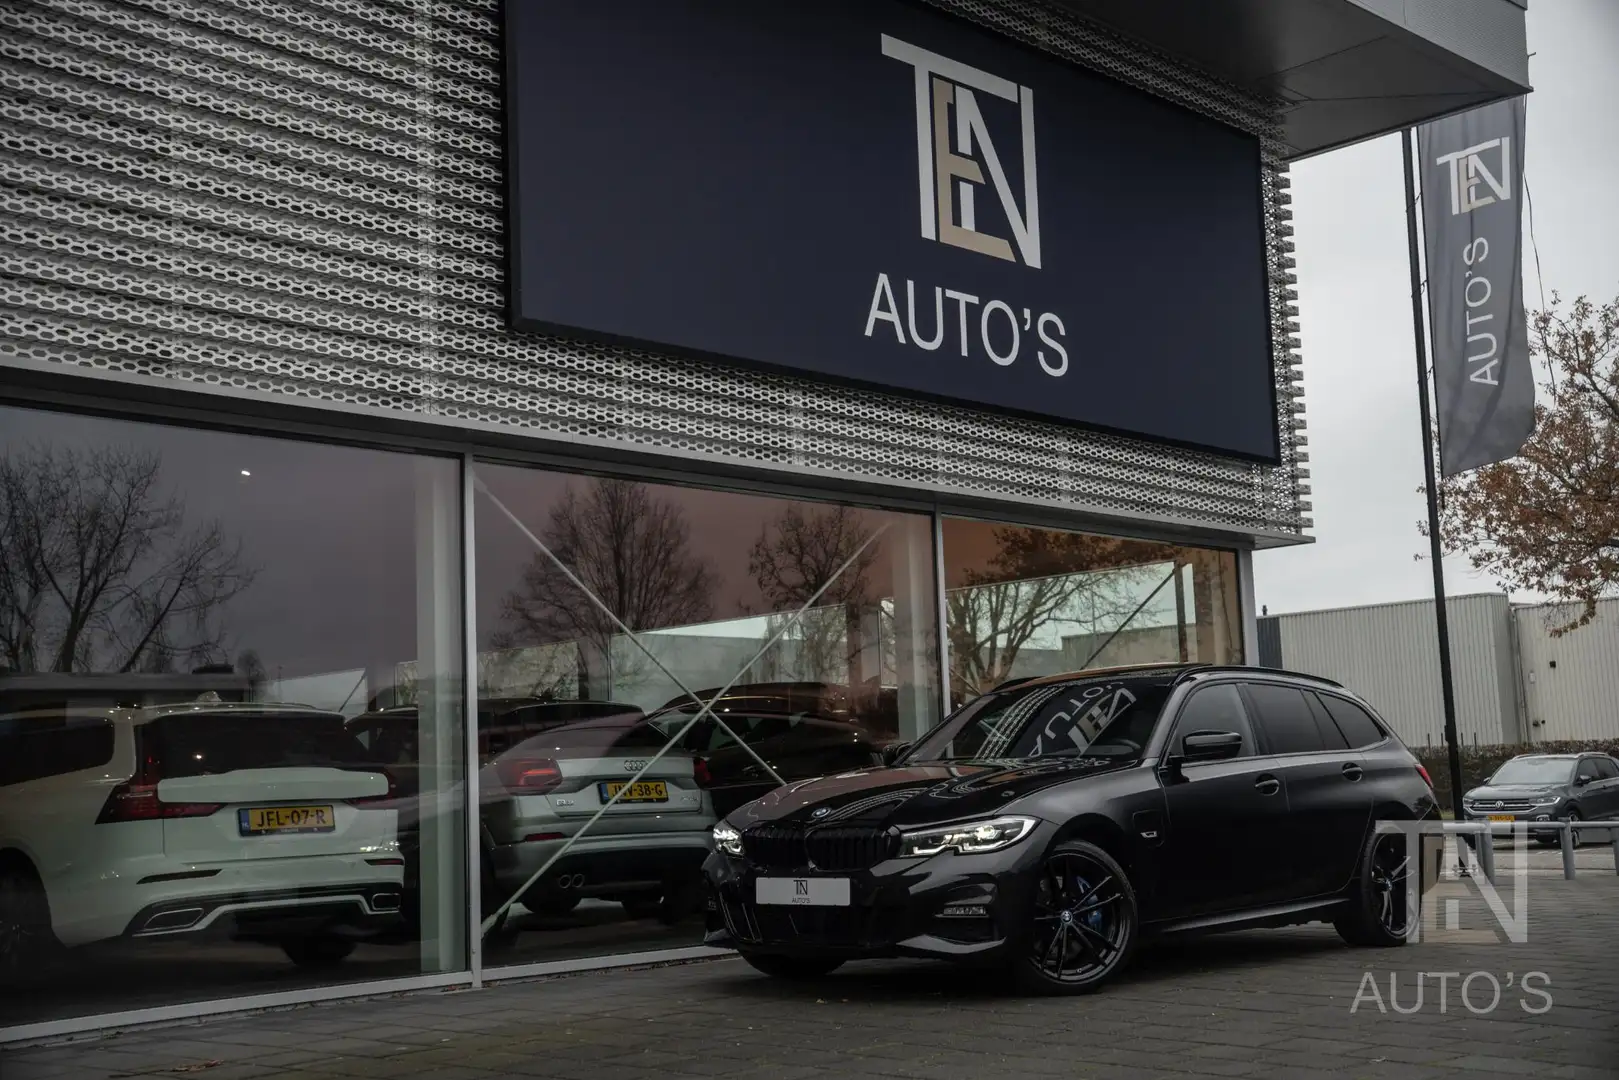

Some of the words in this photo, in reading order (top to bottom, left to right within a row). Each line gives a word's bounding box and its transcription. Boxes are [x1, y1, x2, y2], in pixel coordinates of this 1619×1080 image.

[881, 33, 1042, 269] TEN
[864, 272, 1069, 377] AUTO'S
[1463, 237, 1499, 386] AUTO'S
[256, 809, 326, 827] JFL-07-R
